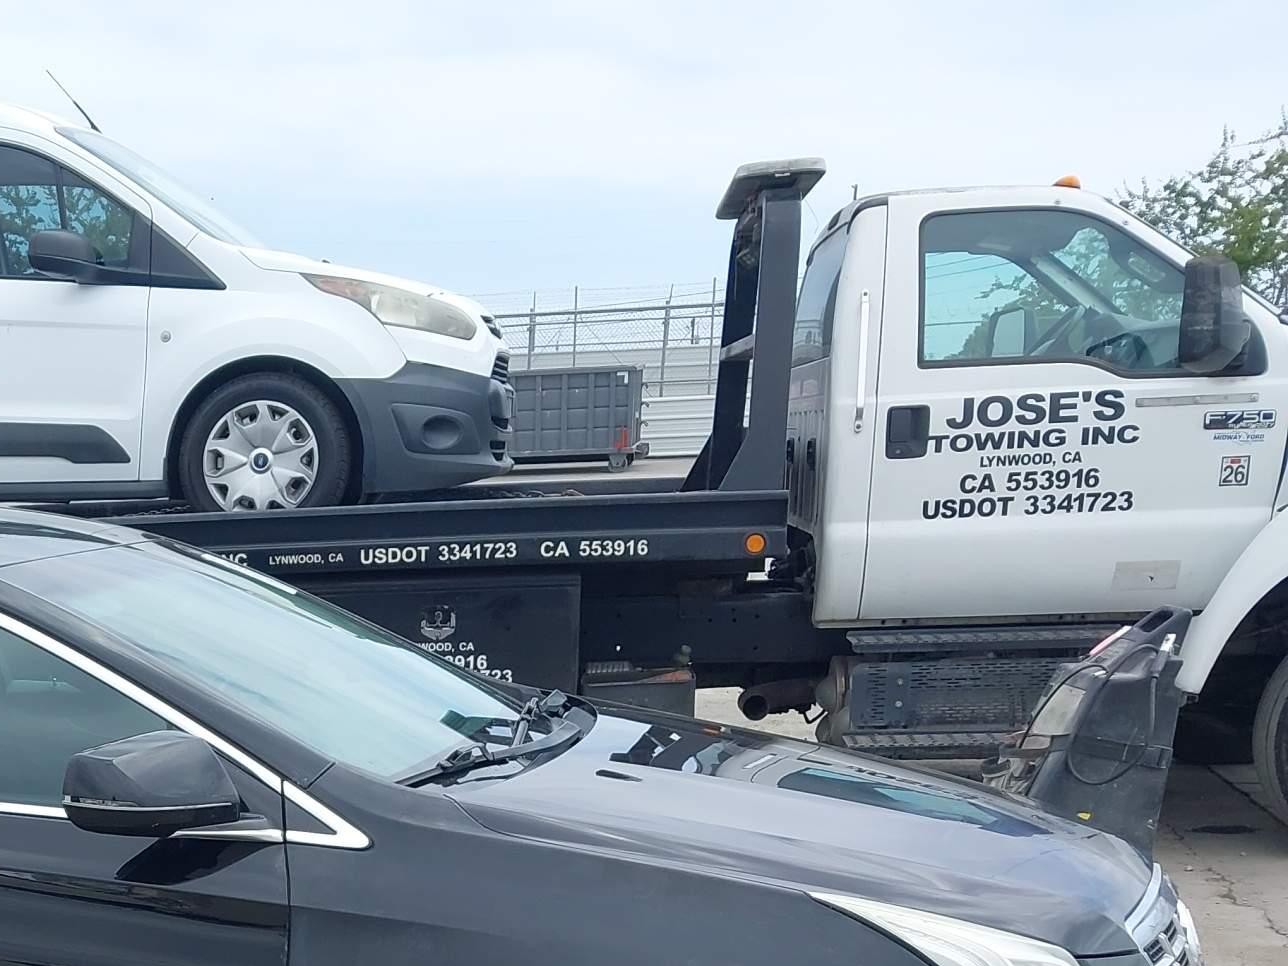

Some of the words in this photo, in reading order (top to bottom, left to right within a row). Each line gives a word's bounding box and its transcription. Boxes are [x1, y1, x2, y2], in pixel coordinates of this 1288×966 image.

[946, 389, 1125, 429] JOSE'S
[928, 428, 1067, 453] TOWING
[1081, 424, 1140, 446] INC
[1213, 433, 1242, 441] MIDWAY
[979, 452, 1056, 468] LYNWOOD,
[1062, 451, 1082, 464] CA
[959, 473, 996, 494] CA
[1006, 468, 1100, 492] 553916
[1222, 464, 1246, 484] 26
[922, 496, 1015, 520] USDOT
[1024, 491, 1134, 515] 3341723
[220, 553, 248, 568] NC
[269, 554, 325, 566] LYNWOOD,
[328, 553, 345, 564] CA
[360, 546, 430, 565] USDOT
[438, 542, 518, 562] 3341723
[540, 541, 570, 557] CA
[579, 540, 649, 557] 553916
[418, 642, 455, 653] WOOD,
[459, 642, 475, 652] CA
